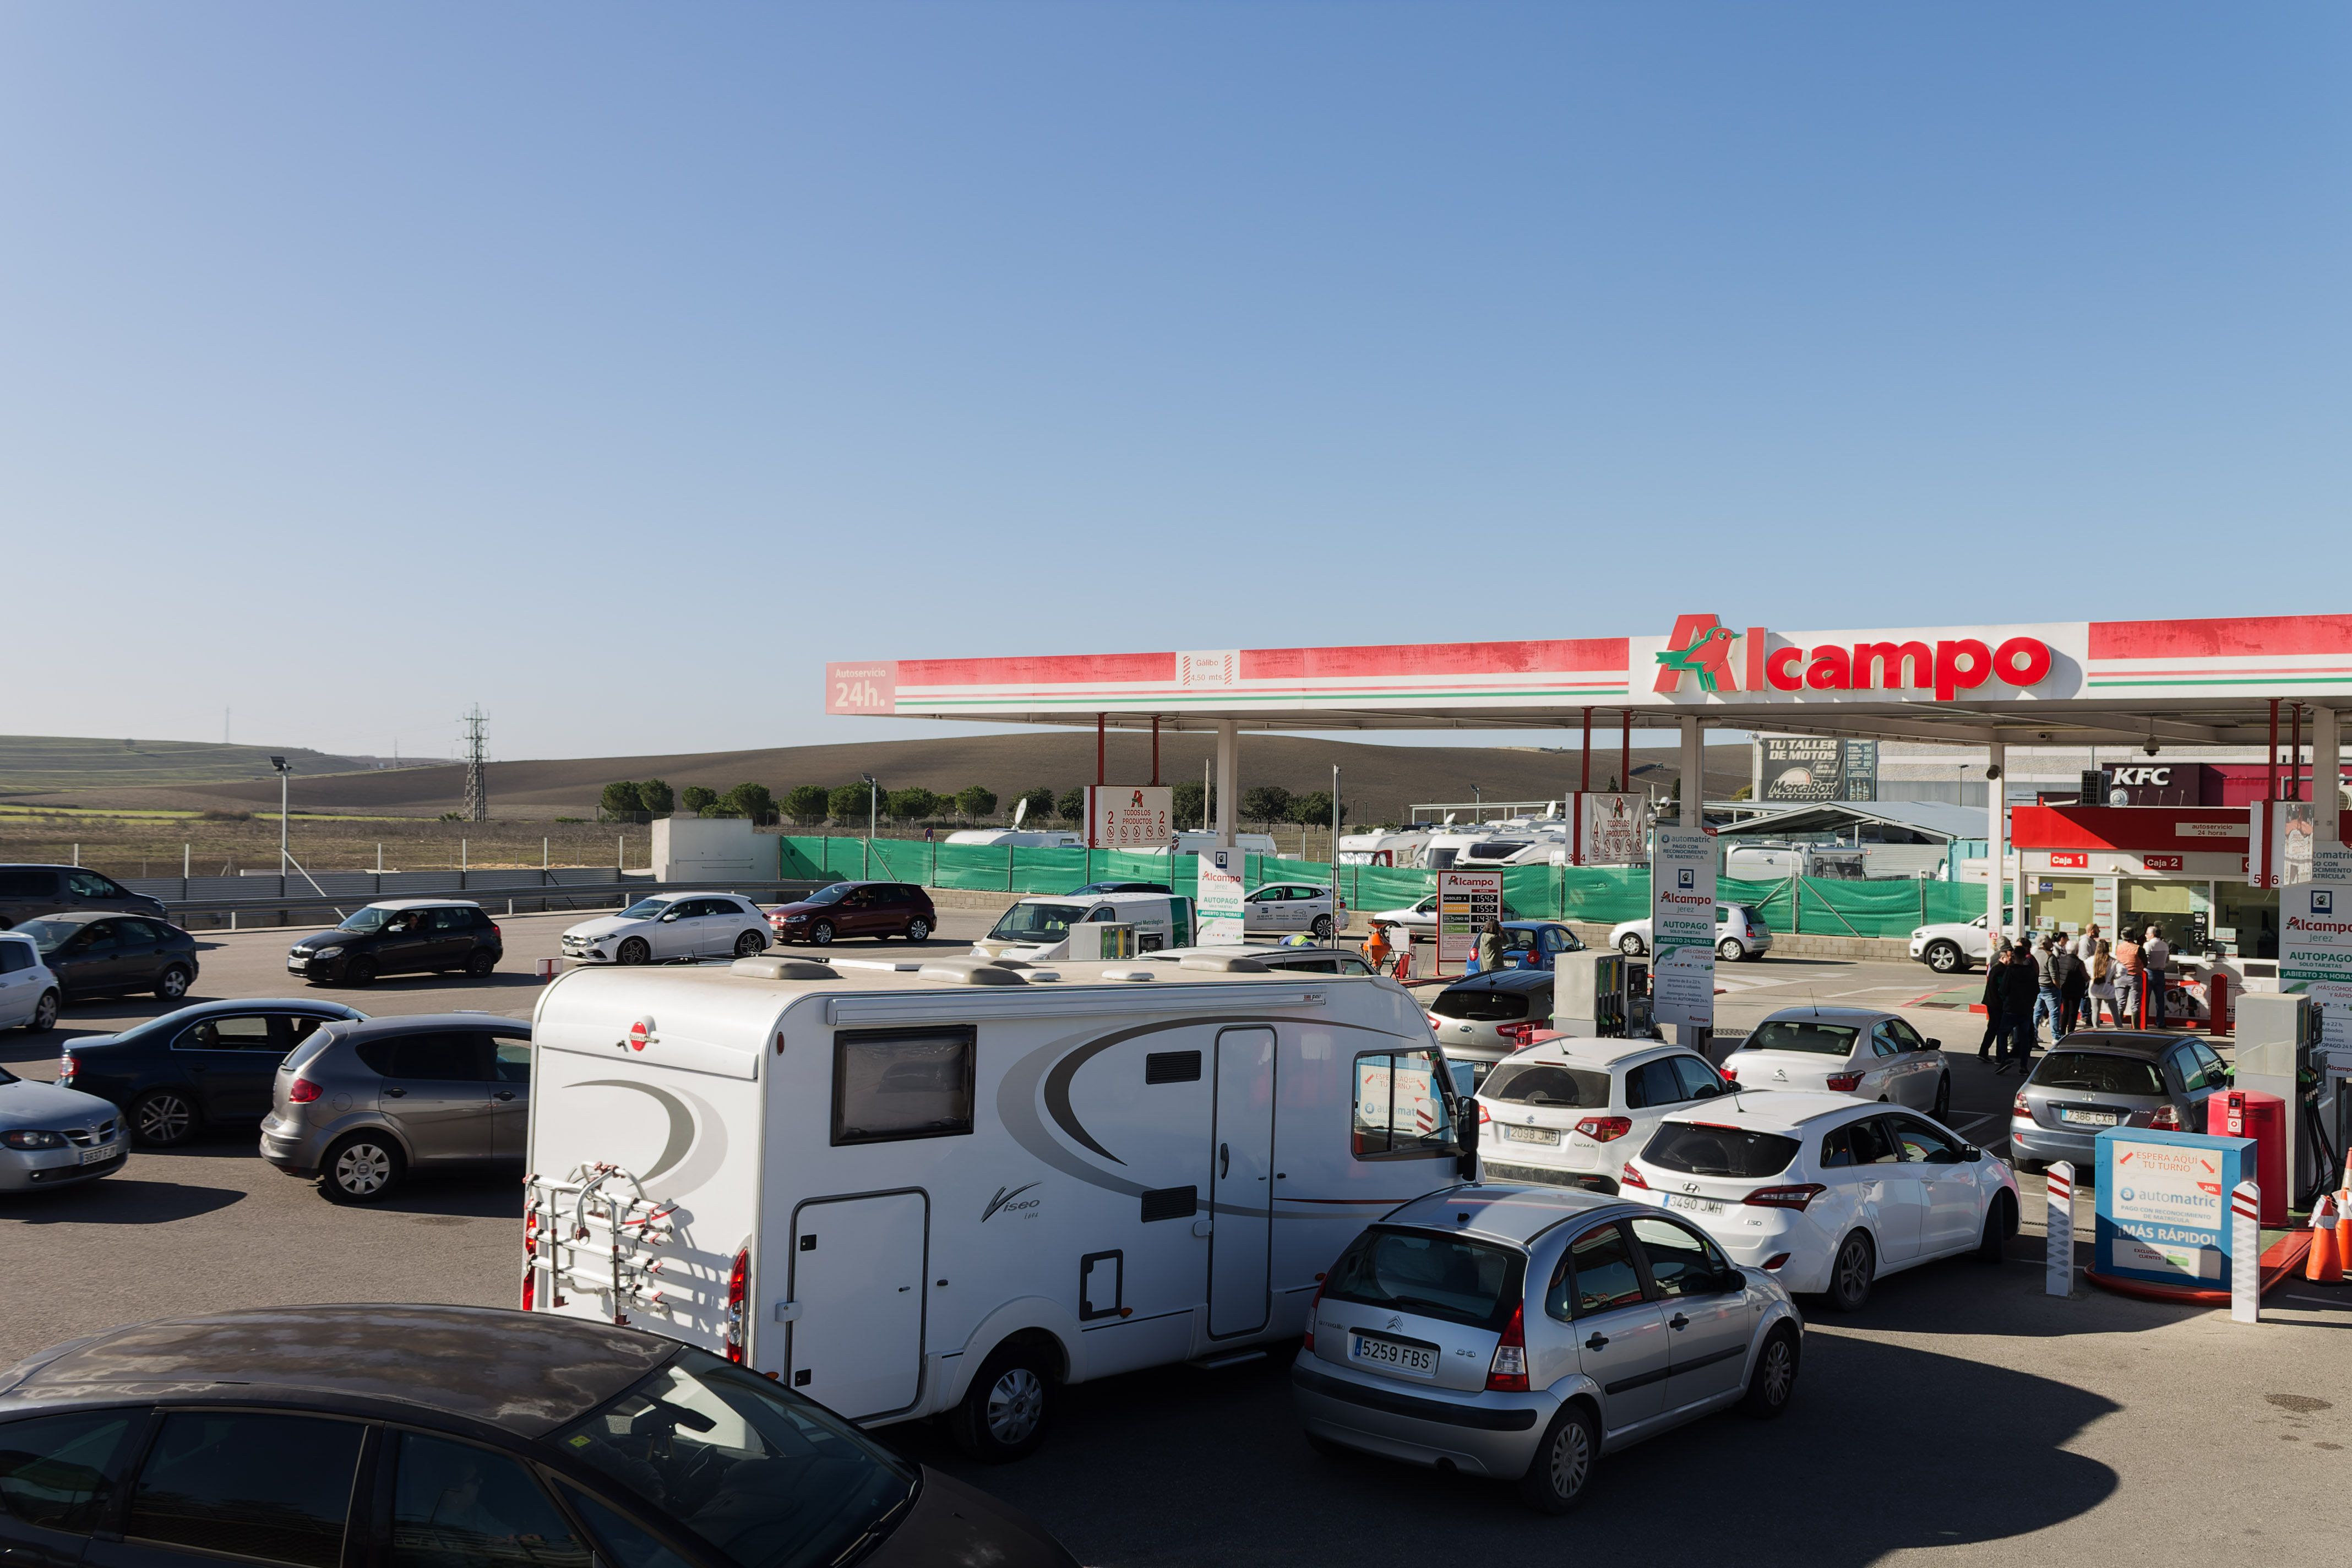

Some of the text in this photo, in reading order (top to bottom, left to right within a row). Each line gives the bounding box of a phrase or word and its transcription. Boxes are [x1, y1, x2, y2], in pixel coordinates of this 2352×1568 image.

[1652, 614, 2052, 701] Alcampo
[835, 668, 886, 678] Autoservicio
[835, 680, 885, 707] 24h.
[1769, 741, 1837, 749] TU TALLER
[1769, 751, 1837, 760] DE MOTOS
[2111, 767, 2171, 785] KFC
[1768, 780, 1837, 794] MercaBox
[1108, 810, 1114, 824] 2
[1159, 810, 1164, 824] 2
[1594, 821, 1598, 837] 4
[1636, 821, 1640, 836] 4
[2052, 856, 2083, 865] Caja 1
[2147, 858, 2177, 868] Caja 2
[1202, 871, 1241, 883] Alcampo
[1448, 875, 1493, 886] Alcampo
[2253, 874, 2261, 883] 5
[2272, 875, 2278, 884] 6
[1660, 891, 1711, 906] Alcampo
[1663, 921, 1708, 930] AUTOPAGO
[2309, 934, 2333, 942] Jerez
[2068, 1110, 2091, 1121] 7386
[2095, 1114, 2114, 1124] CXR
[1511, 1128, 1556, 1142] 2098 JMB
[2136, 1151, 2198, 1164] ESPERA AQUÍ
[2158, 1163, 2190, 1172] TURNO
[1670, 1196, 1723, 1215] 3490 JMH
[2139, 1191, 2215, 1208] automatric
[2153, 1213, 2190, 1223] MATRÍCULA
[2155, 1209, 2211, 1220] RECONOCIMIENTO
[2118, 1224, 2216, 1245] ¡MÁS RÁPIDO!
[1363, 1340, 1429, 1369] 5259 FBS
